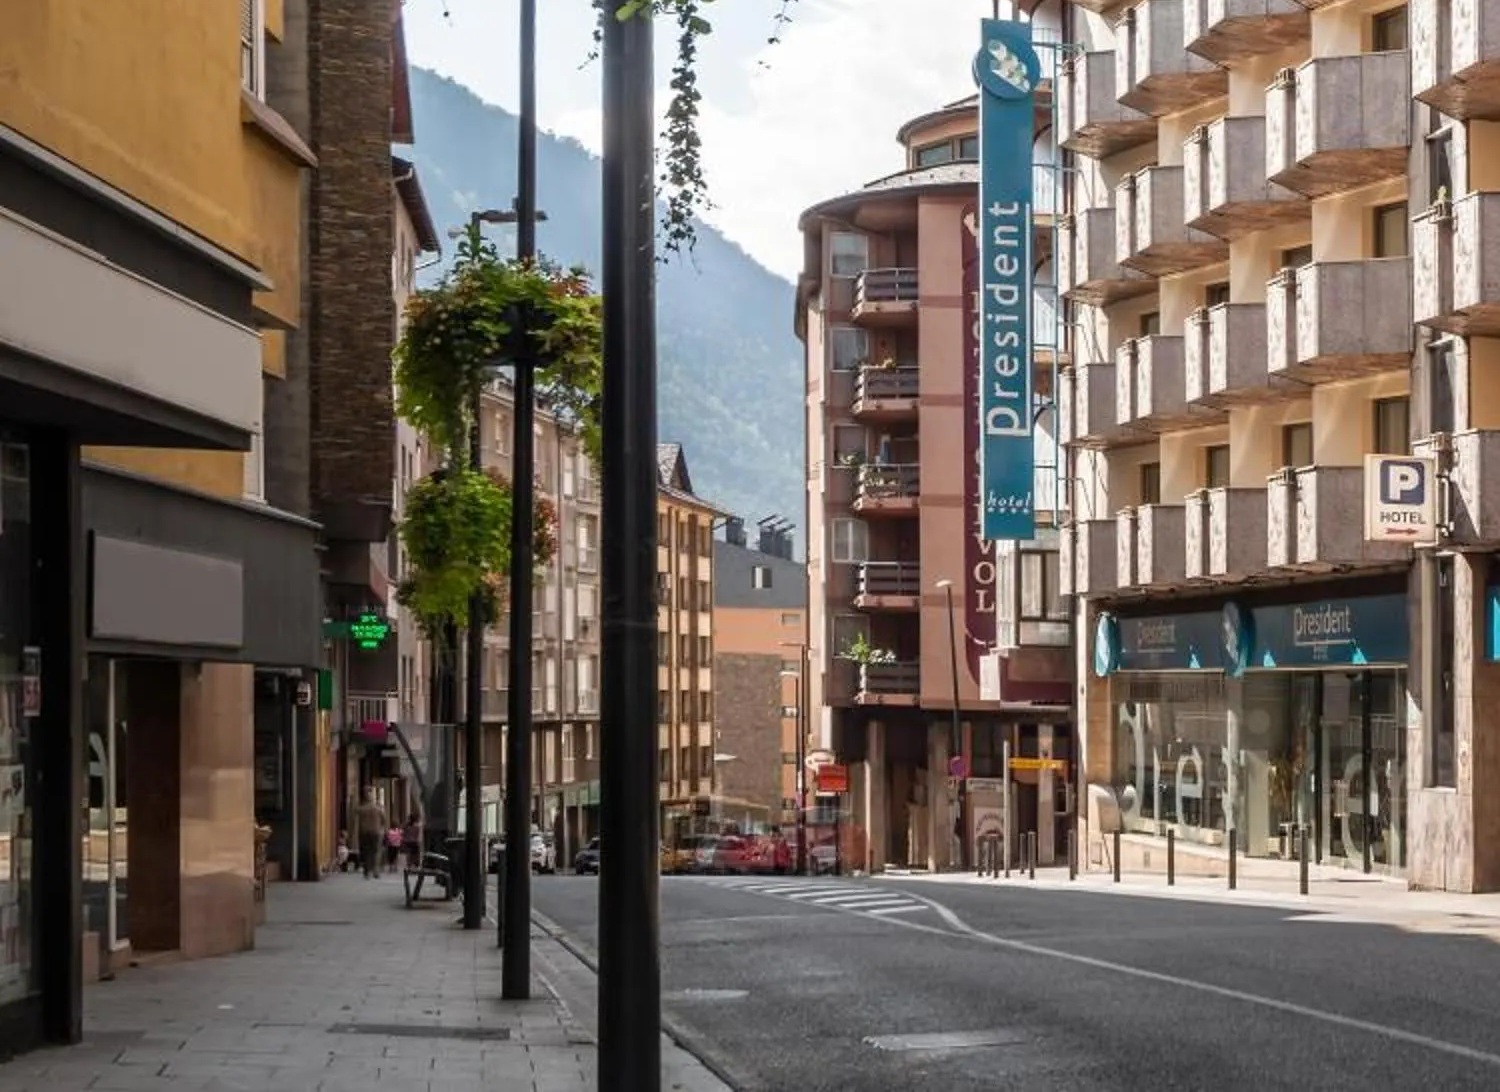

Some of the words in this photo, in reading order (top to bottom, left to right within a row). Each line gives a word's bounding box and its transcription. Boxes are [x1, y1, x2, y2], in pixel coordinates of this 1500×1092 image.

[1388, 464, 1420, 501] P
[987, 490, 1032, 507] hotel
[1380, 510, 1427, 525] HOTEL
